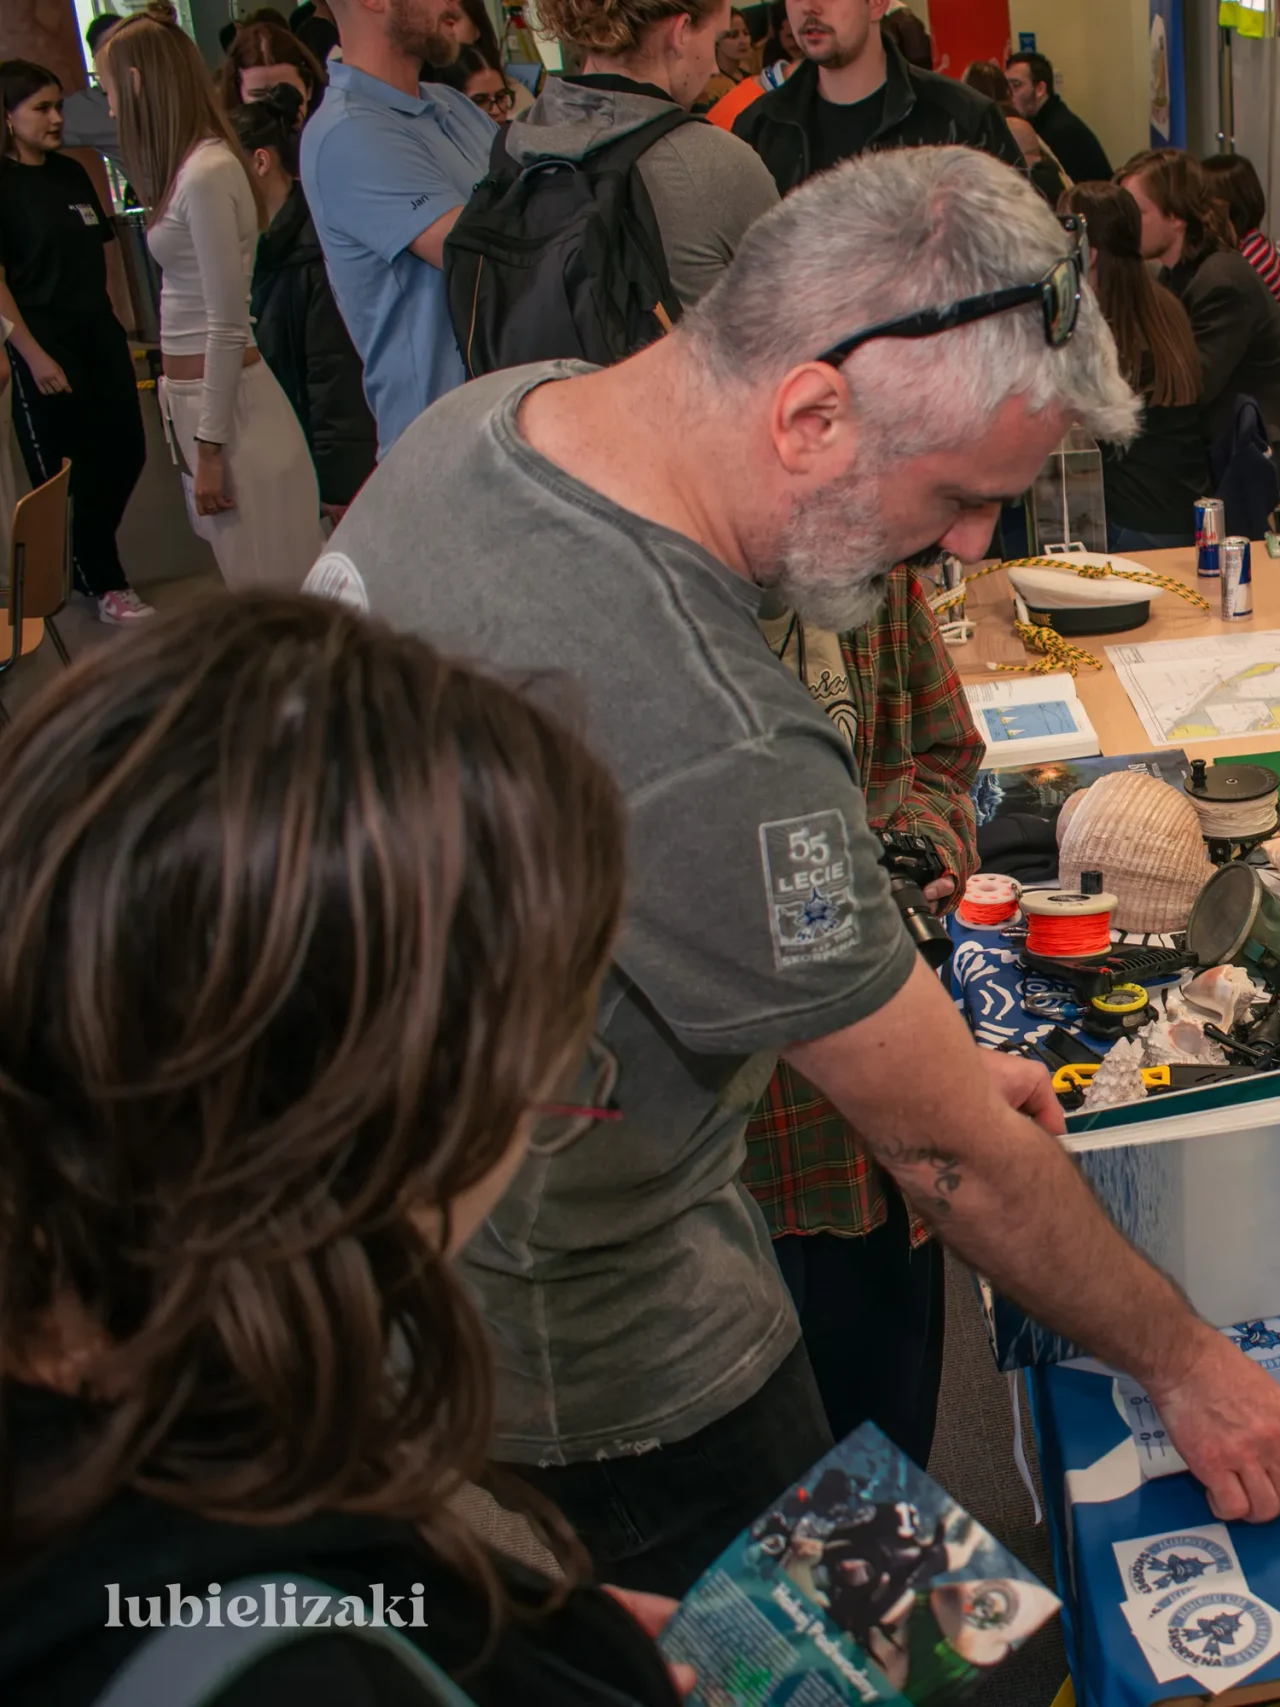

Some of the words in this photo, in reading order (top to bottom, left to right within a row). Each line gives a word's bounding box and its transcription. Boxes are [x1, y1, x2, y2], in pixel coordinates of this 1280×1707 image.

[410, 194, 430, 211] Jan
[789, 828, 831, 867] 55
[778, 861, 846, 894] LECIE
[1167, 1627, 1223, 1667] SKORPENA
